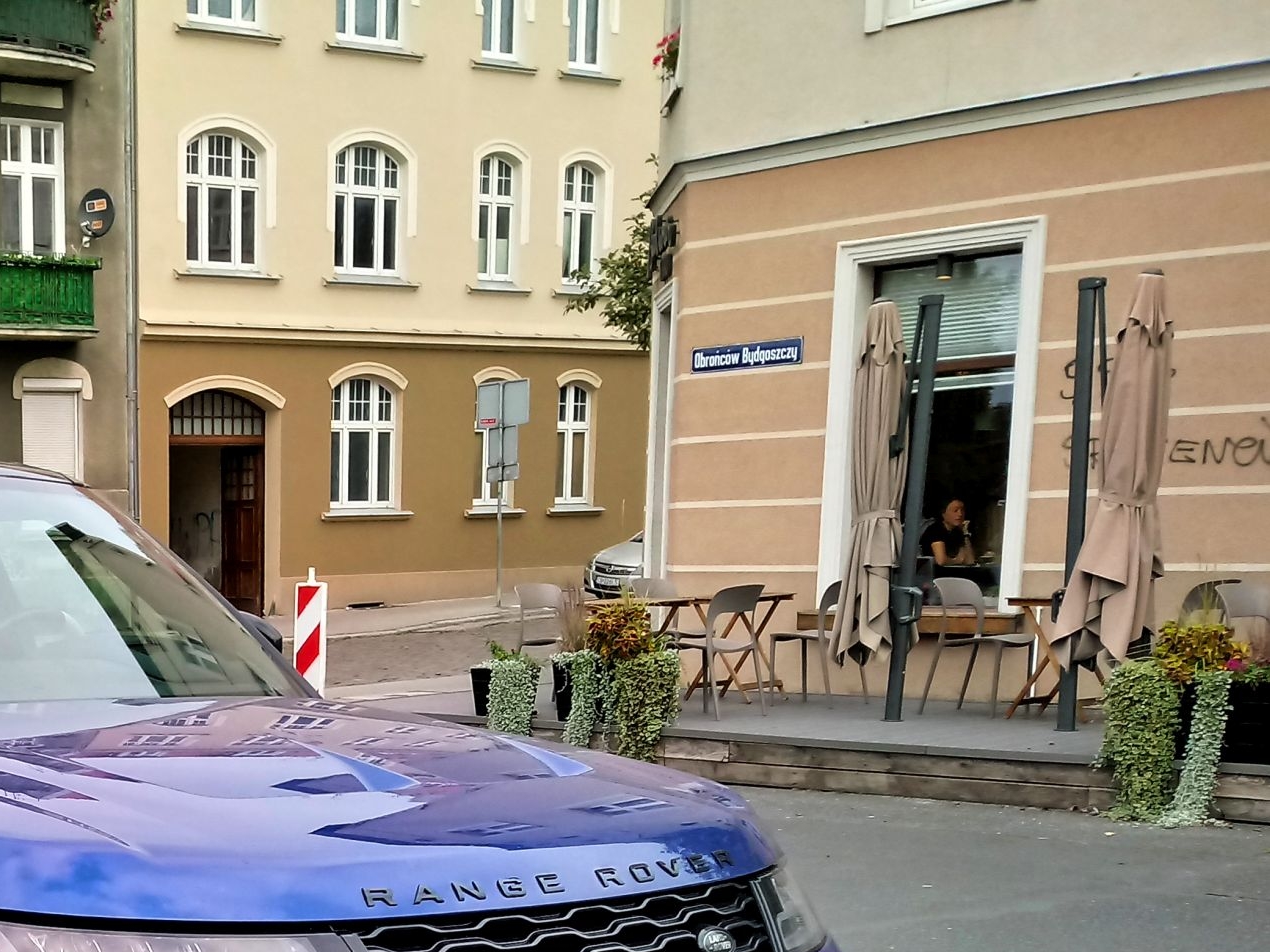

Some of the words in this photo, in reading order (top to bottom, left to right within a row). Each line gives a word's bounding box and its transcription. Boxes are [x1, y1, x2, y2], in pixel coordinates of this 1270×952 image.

[694, 349, 740, 369] Obrońców
[742, 345, 798, 366] Bydgoszczy
[361, 873, 566, 908] RANGE
[594, 849, 736, 888] ROVER
